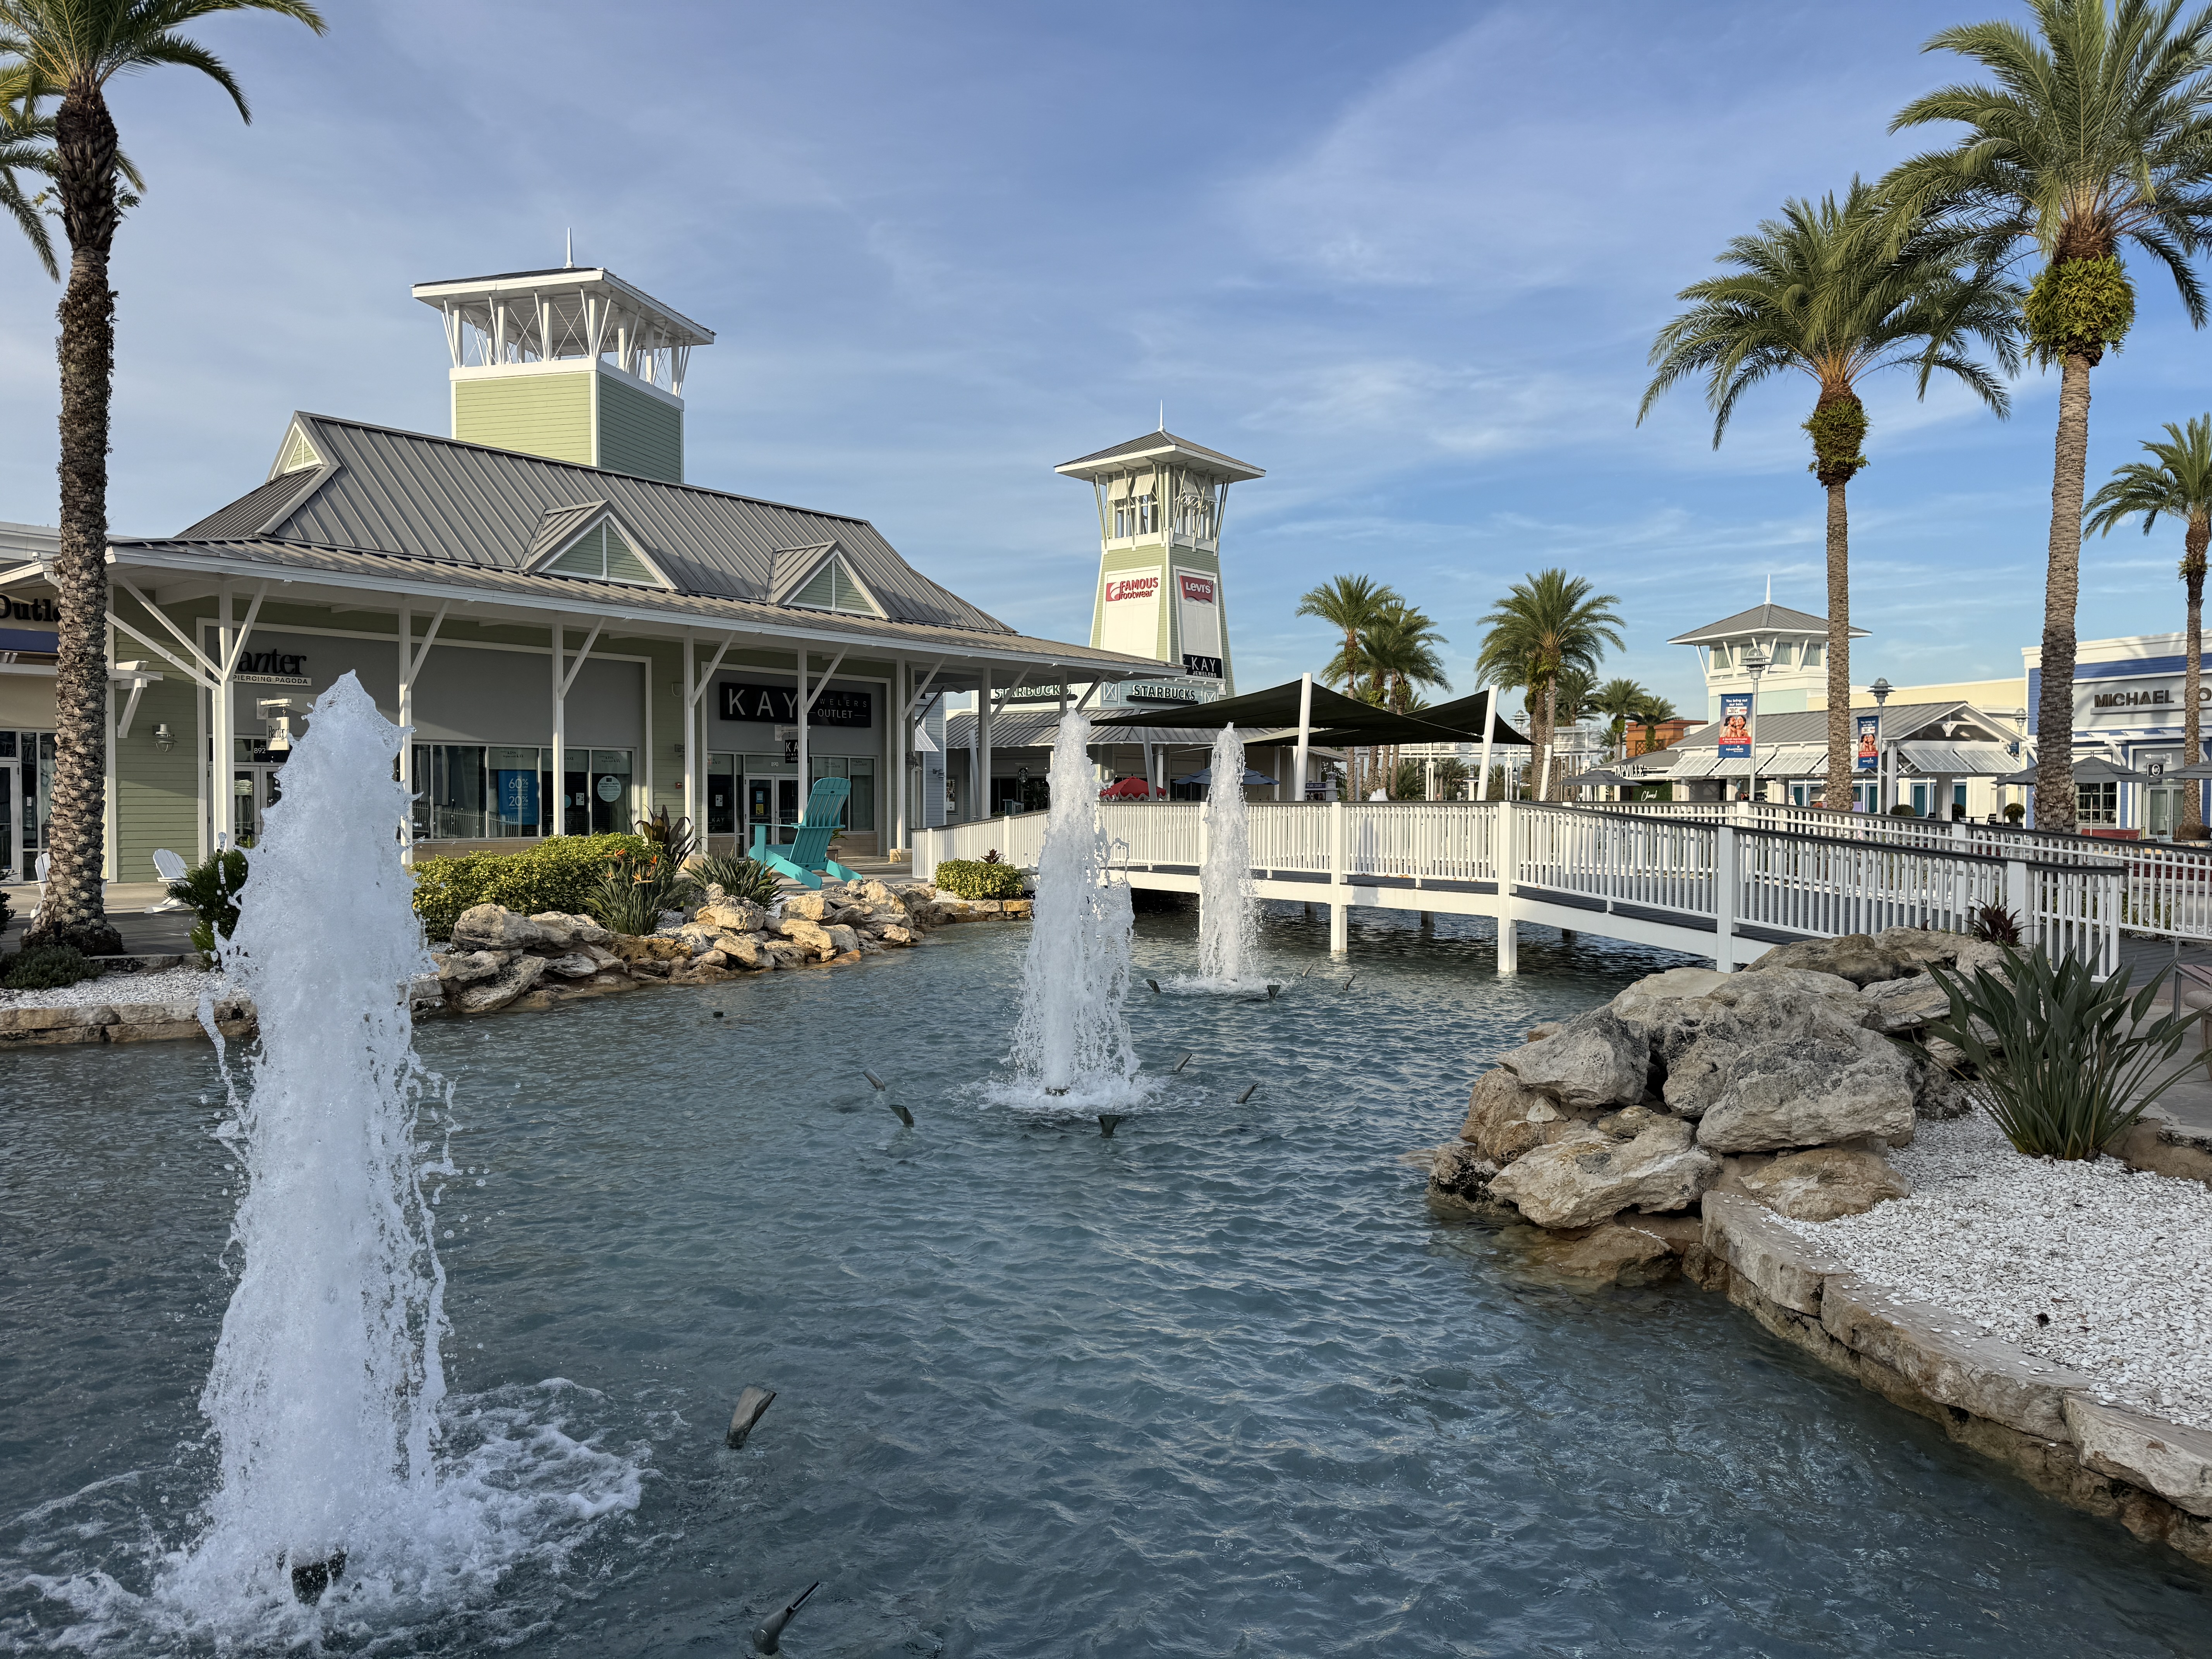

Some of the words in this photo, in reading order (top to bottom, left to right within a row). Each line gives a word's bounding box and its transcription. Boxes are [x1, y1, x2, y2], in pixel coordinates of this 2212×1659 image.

[1120, 577, 1158, 591] FAMOUS
[232, 645, 307, 675] anter
[1191, 656, 1216, 672] KAY
[1133, 685, 1195, 701] STARBUCKS
[2094, 690, 2174, 708] MICHAEL
[729, 689, 798, 718] KAY
[819, 698, 867, 708] WELERS
[817, 709, 853, 718] OUTLET
[268, 725, 285, 739] Banter
[786, 742, 799, 752] KA
[1613, 764, 1644, 778] TAPVILLE
[508, 778, 529, 789] 60%
[508, 796, 529, 806] 20%
